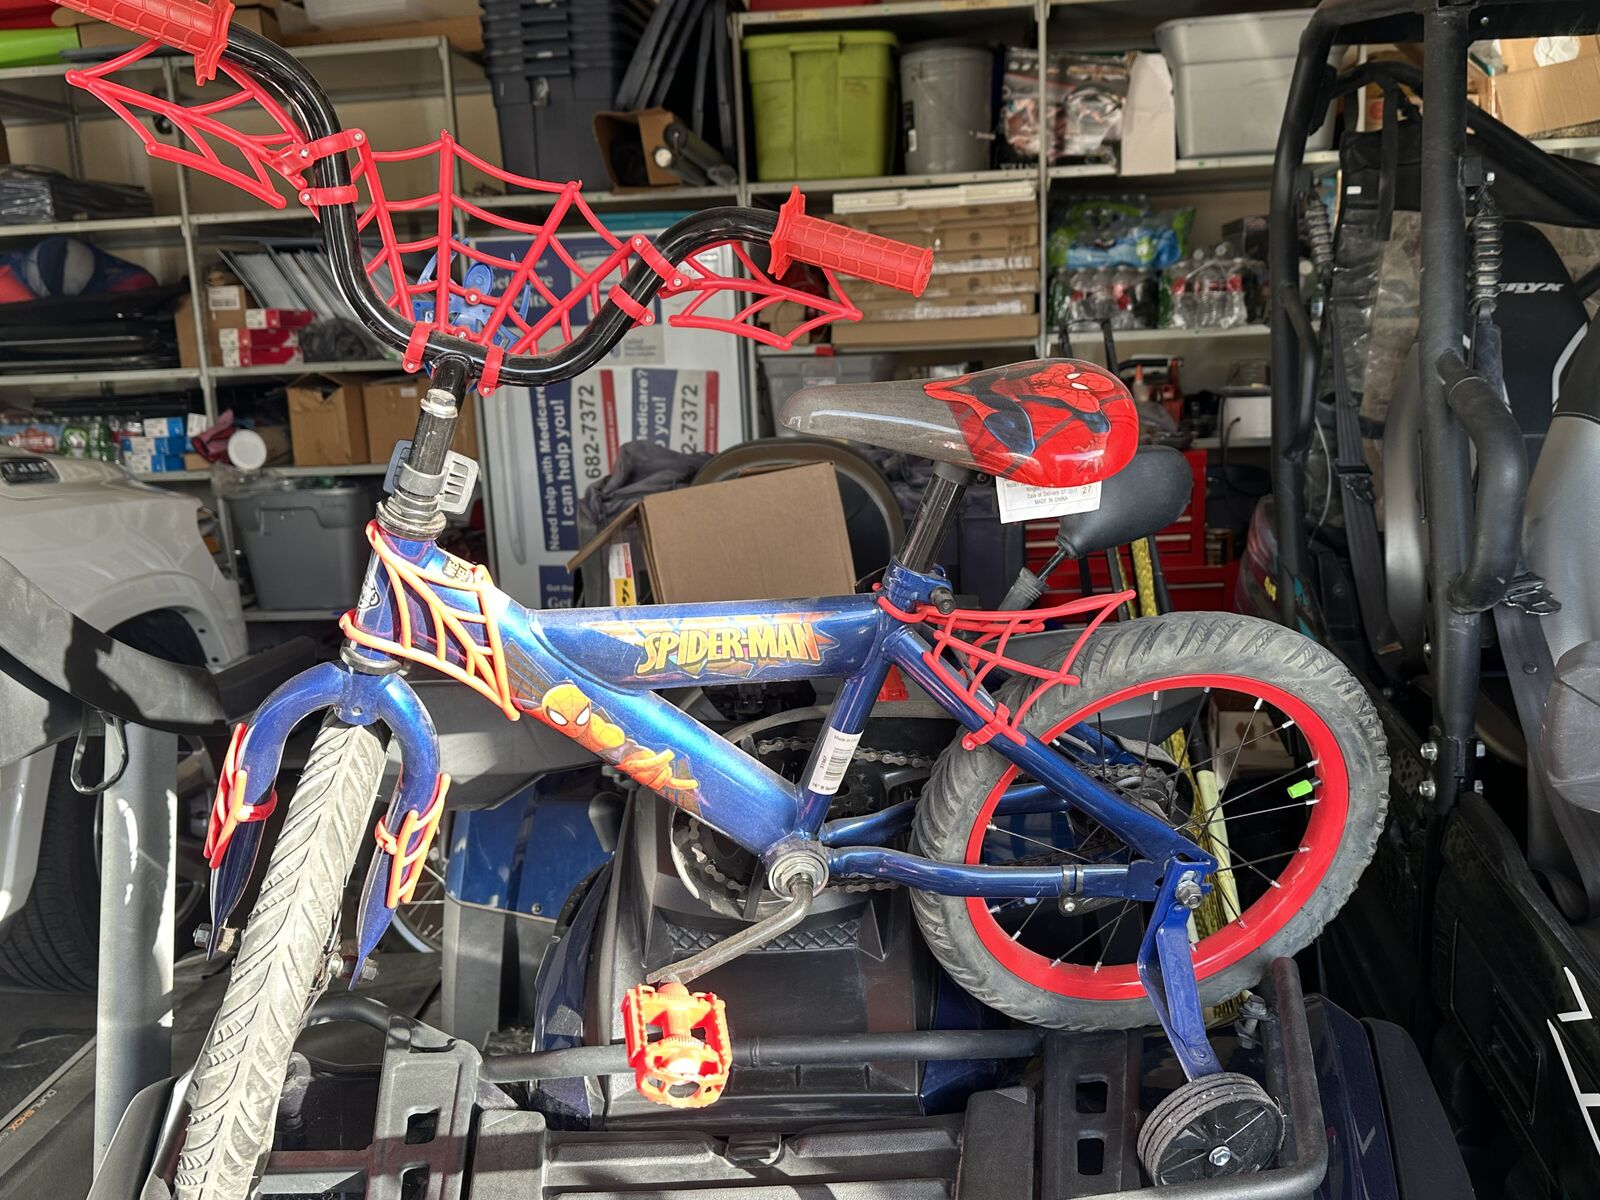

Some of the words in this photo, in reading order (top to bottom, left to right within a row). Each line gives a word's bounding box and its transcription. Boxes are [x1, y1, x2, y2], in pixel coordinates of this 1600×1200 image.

[549, 399, 570, 439] you!
[578, 385, 602, 479] 682-7372
[651, 396, 669, 436] you!
[542, 456, 554, 485] with
[555, 442, 571, 481] help
[544, 486, 558, 515] help
[561, 485, 575, 516] can
[547, 517, 561, 551] Need
[637, 622, 821, 674] SPIDER-MAN
